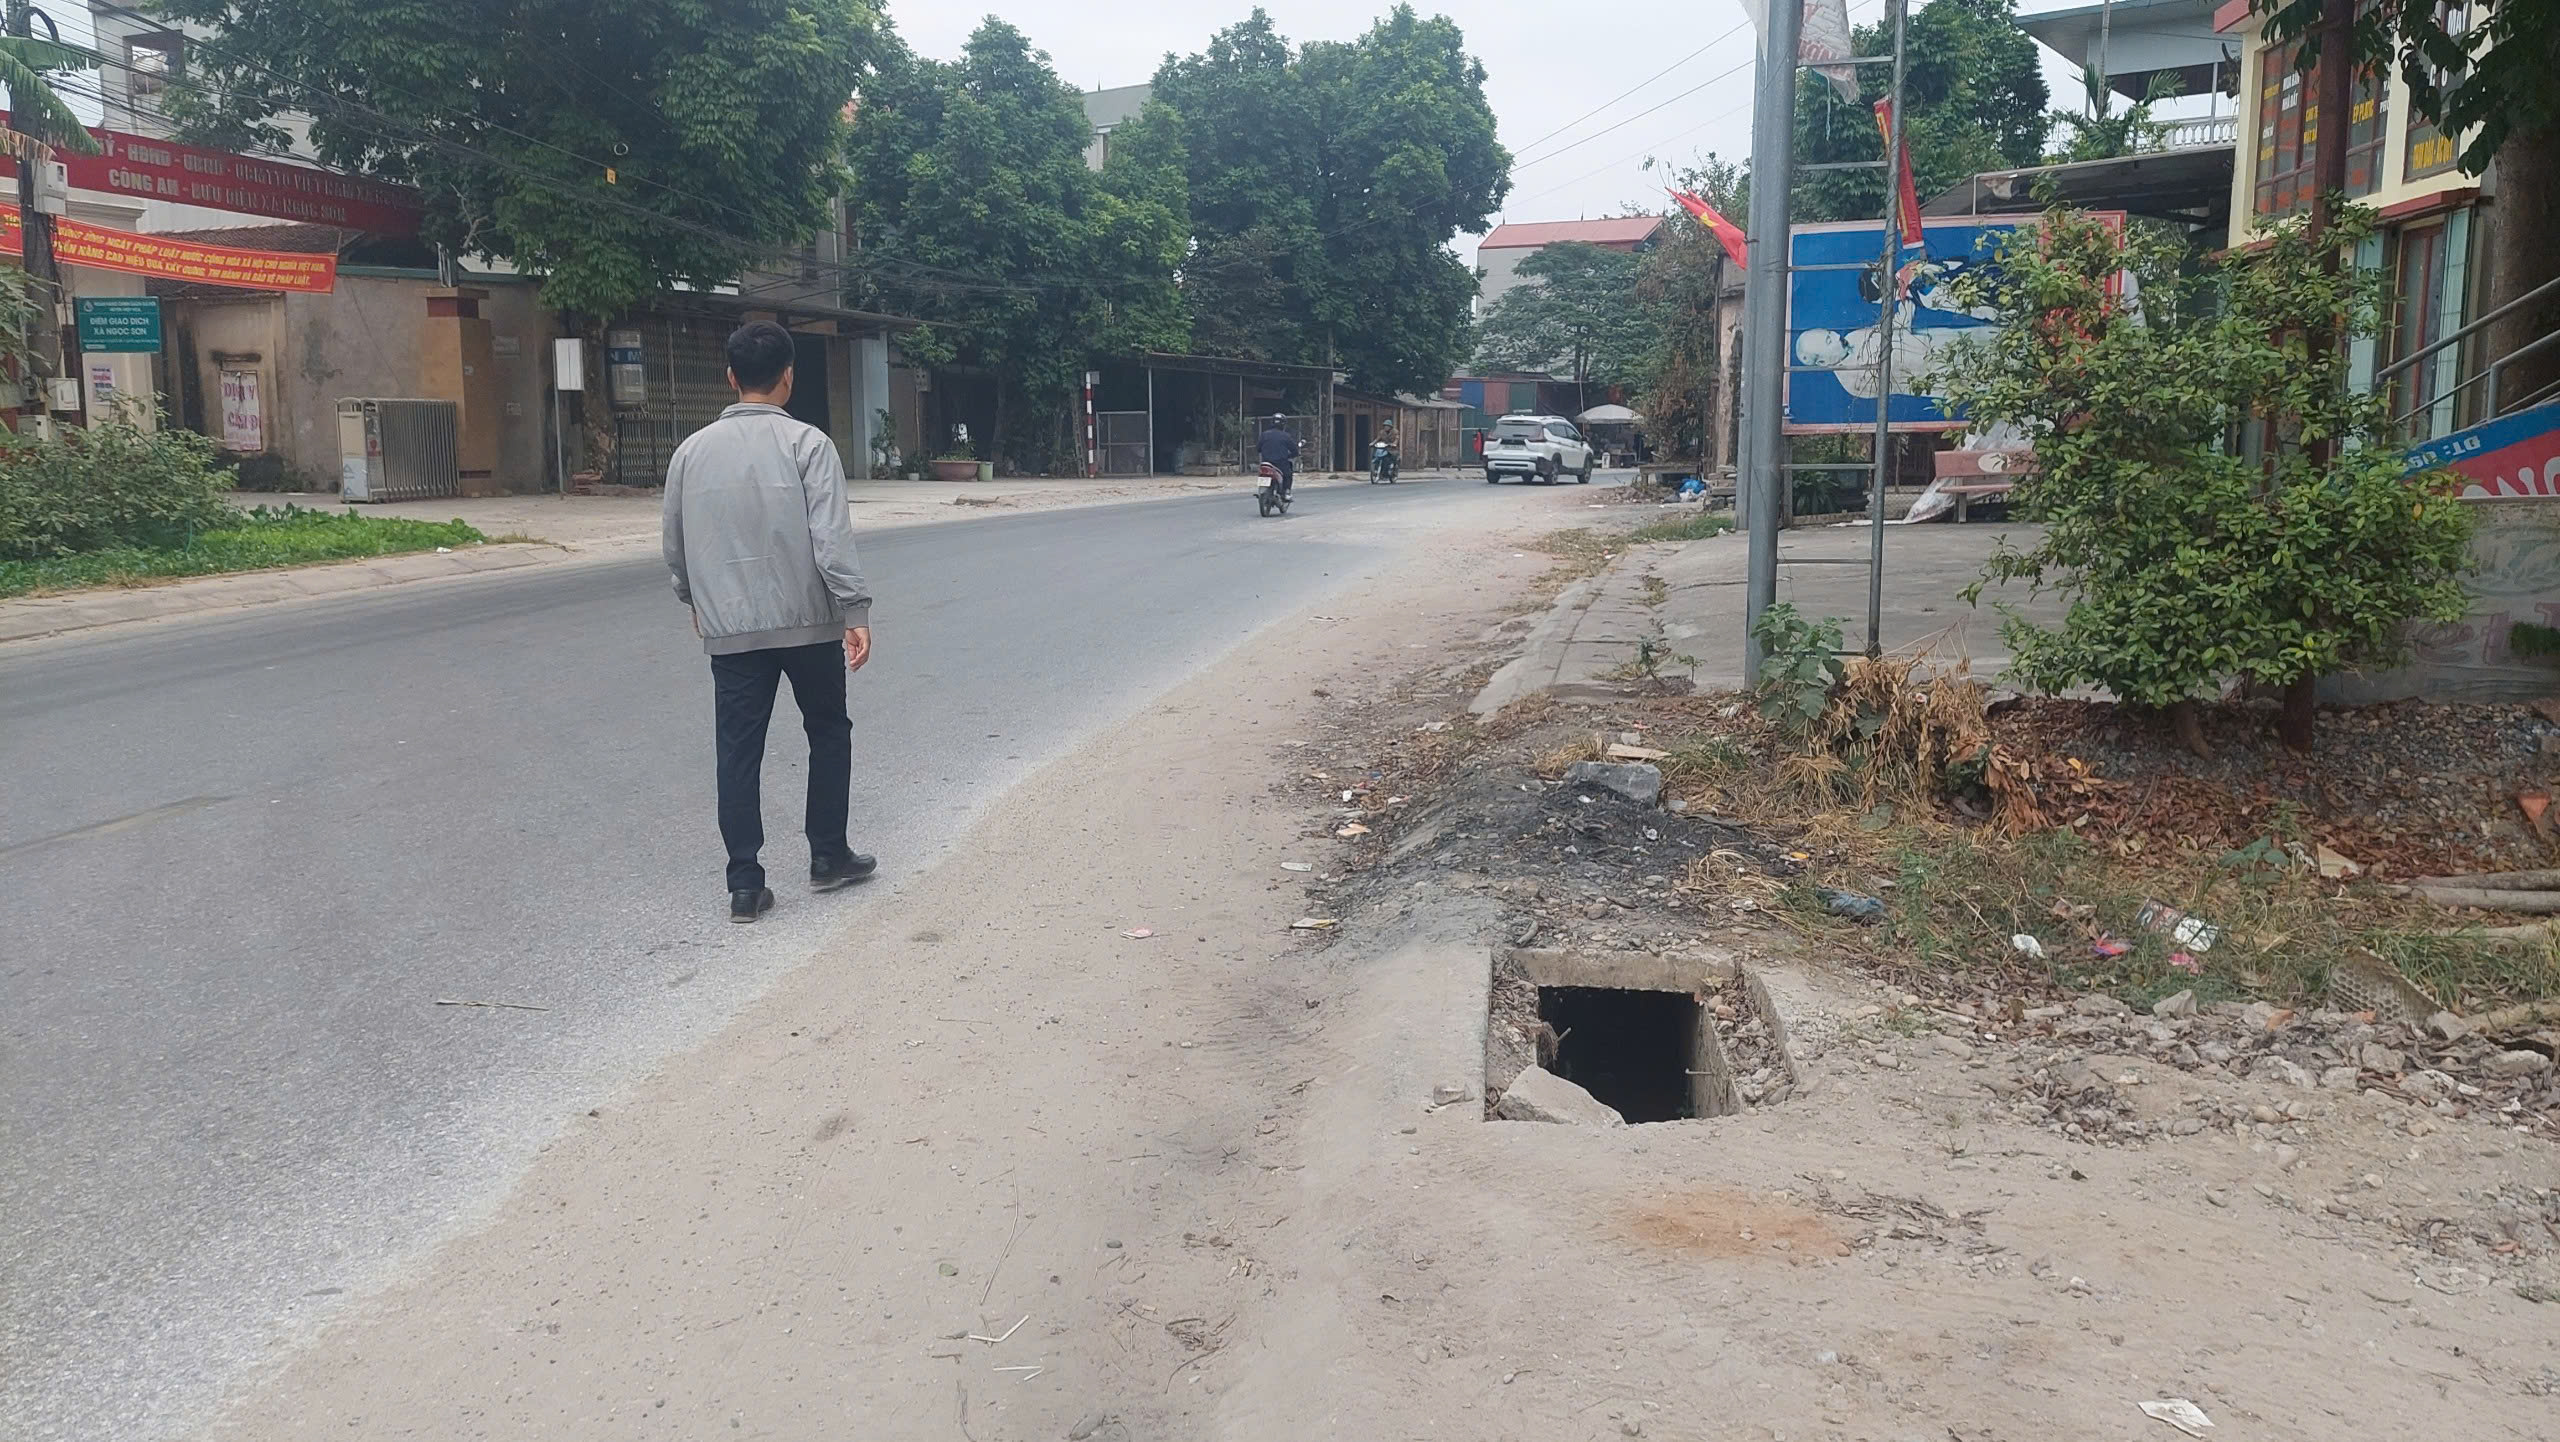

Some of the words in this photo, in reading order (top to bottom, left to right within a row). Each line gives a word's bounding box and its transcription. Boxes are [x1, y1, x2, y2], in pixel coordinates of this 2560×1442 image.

[108, 166, 153, 192] CÔNG
[157, 177, 180, 196] AN
[105, 250, 124, 263] CAO
[277, 270, 293, 283] PHÁP
[106, 235, 132, 252] NGÀY
[133, 239, 158, 256] PHÁP
[158, 245, 182, 261] LUẬT
[204, 253, 226, 268] CỘNG
[106, 328, 129, 336] NGỌC
[130, 318, 149, 326] DỊCH
